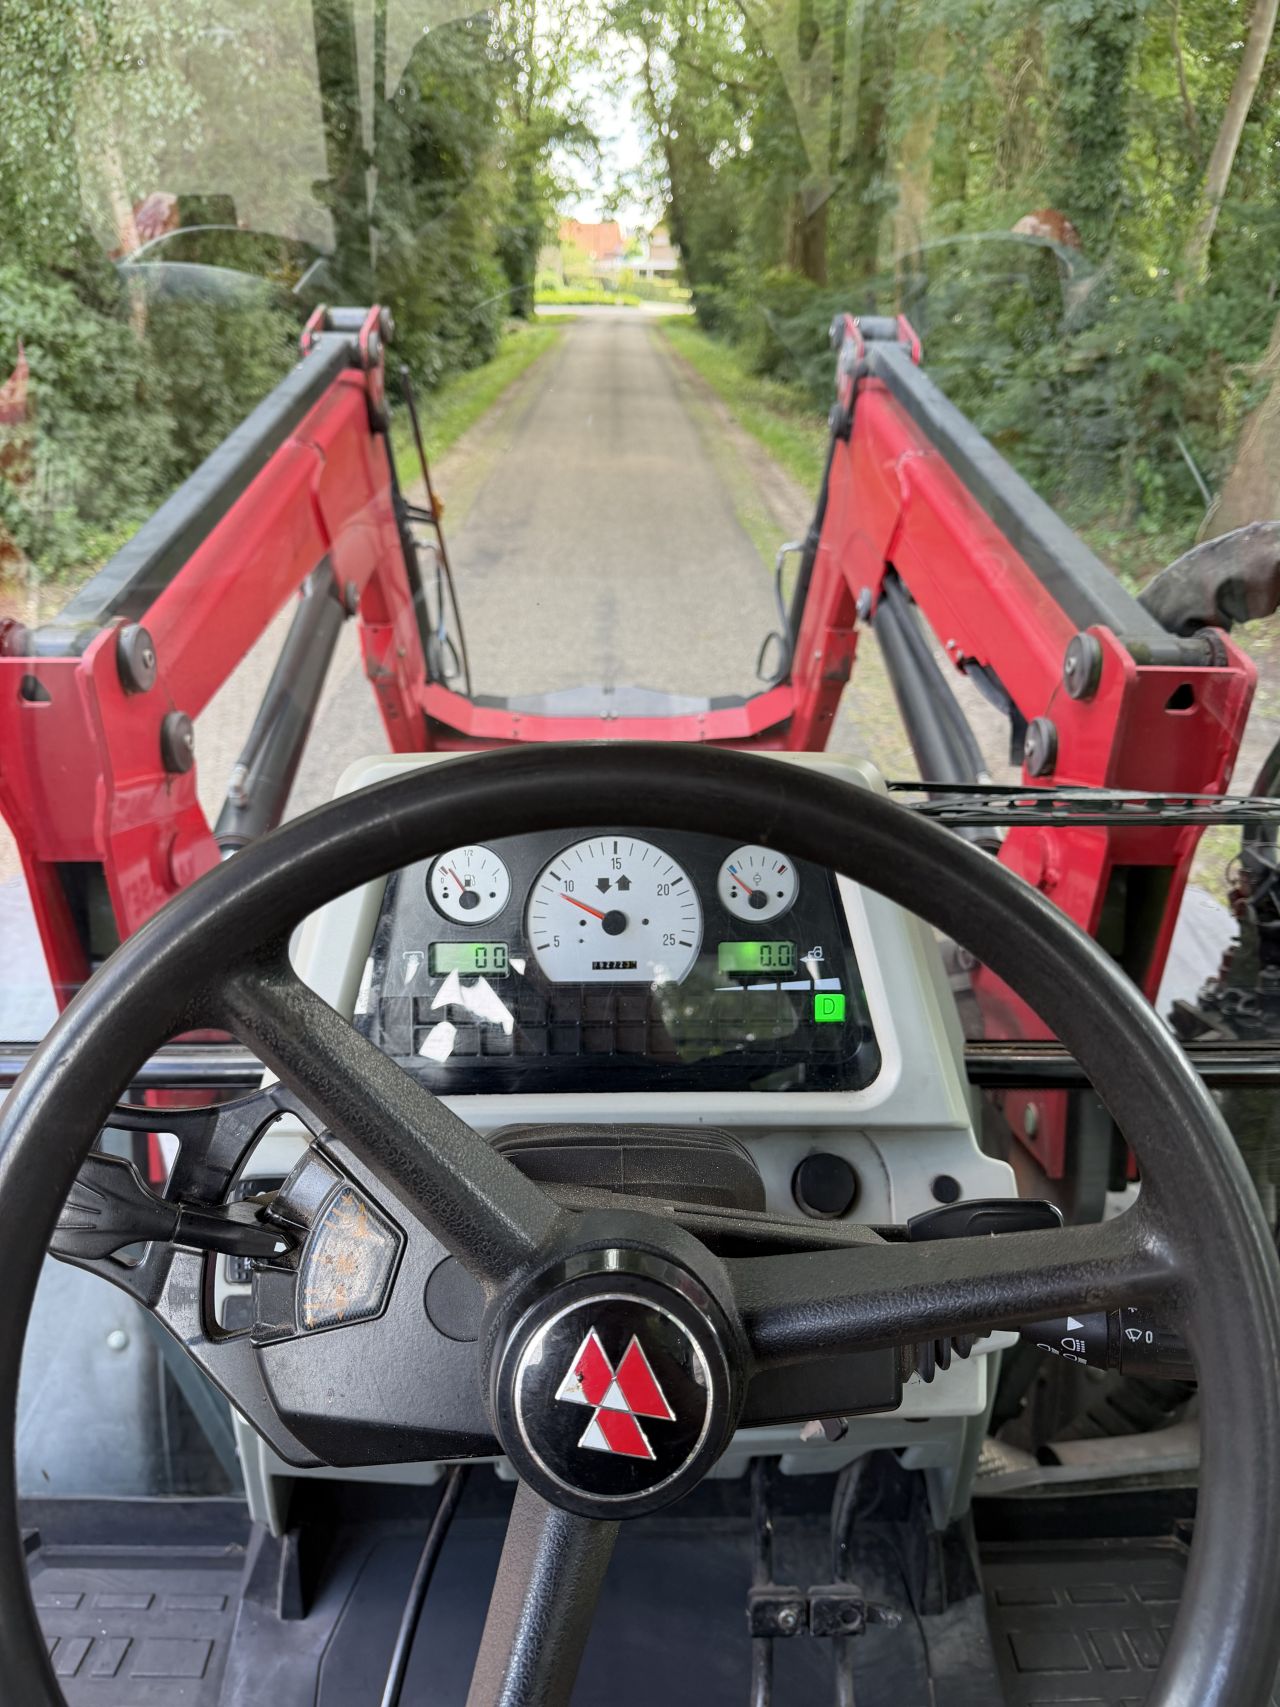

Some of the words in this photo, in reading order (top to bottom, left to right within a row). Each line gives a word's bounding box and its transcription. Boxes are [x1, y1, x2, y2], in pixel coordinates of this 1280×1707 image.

[611, 857, 622, 870] 15
[564, 880, 575, 892] 10
[657, 884, 670, 896] 20
[553, 935, 560, 948] 5
[663, 934, 676, 946] 25
[760, 945, 790, 967] 0.0
[823, 998, 835, 1015] D
